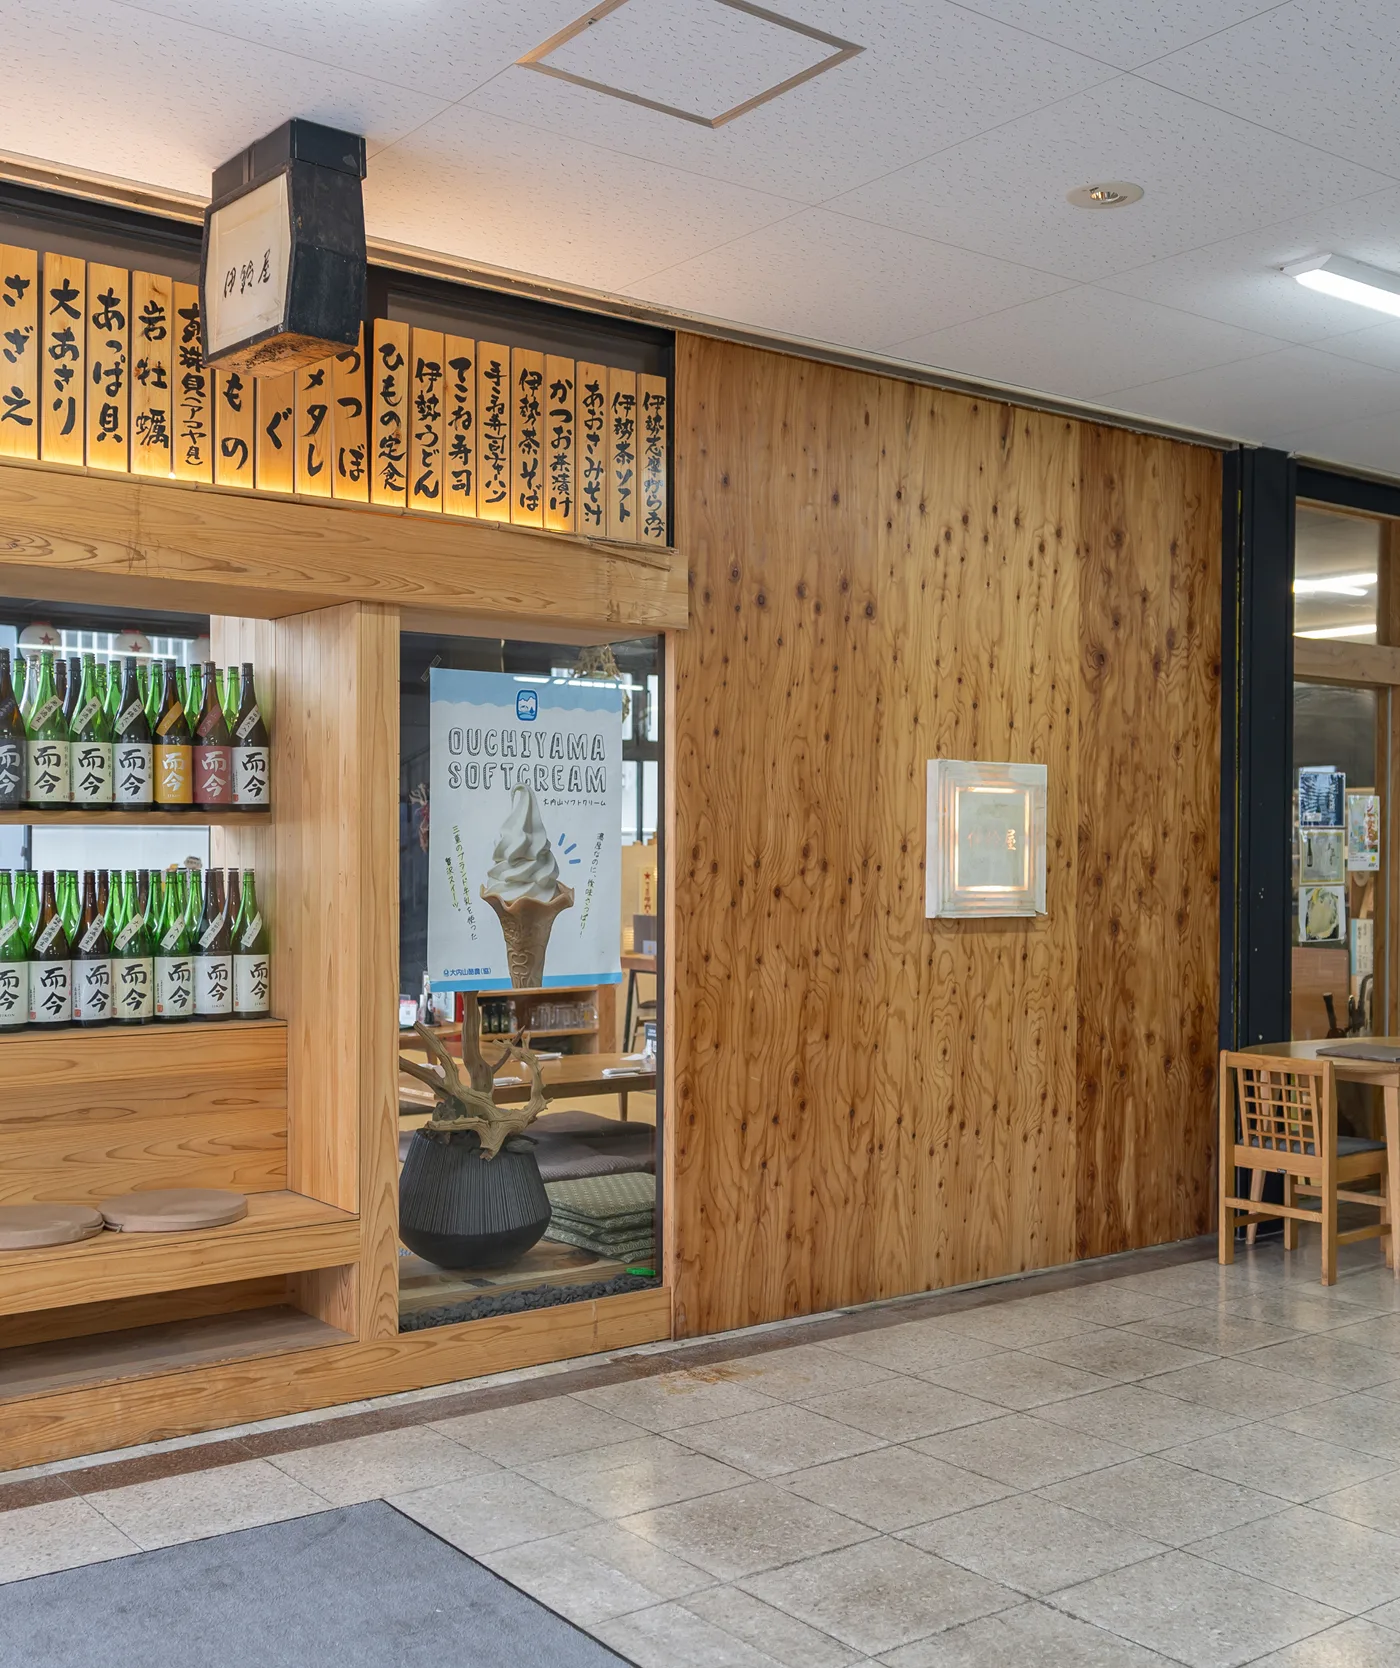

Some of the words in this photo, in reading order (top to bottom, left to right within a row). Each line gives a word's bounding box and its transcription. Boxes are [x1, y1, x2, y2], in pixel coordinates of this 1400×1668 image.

[1, 274, 33, 427] さざえ
[49, 278, 81, 435] 大あさり
[92, 287, 126, 444] あっぱ貝
[136, 300, 170, 449] 岩牡蠣
[378, 343, 406, 492] ひもの定食
[414, 358, 442, 498] 伊勢うどん
[448, 357, 472, 496] てこね寿司
[518, 368, 543, 512] 伊勢茶そば
[549, 378, 573, 517] かつお茶漬け
[582, 380, 604, 526] あおさみそ汁
[611, 392, 636, 523] 伊勢茶ソフト
[448, 727, 606, 761] OUCHIYAMA
[33, 745, 61, 794] 而今
[78, 748, 105, 796] 而今
[119, 749, 146, 796] 而今
[162, 752, 184, 792] 而今
[201, 751, 227, 797] 而今
[241, 752, 266, 797] 而今
[543, 798, 606, 806] 大内山ソフトクリーム
[40, 967, 67, 1016] 而今
[85, 964, 110, 1013] 而今
[121, 963, 147, 1011] 而今
[168, 961, 191, 1009] 而今
[207, 963, 228, 1002] 而今
[249, 961, 268, 999] 而今
